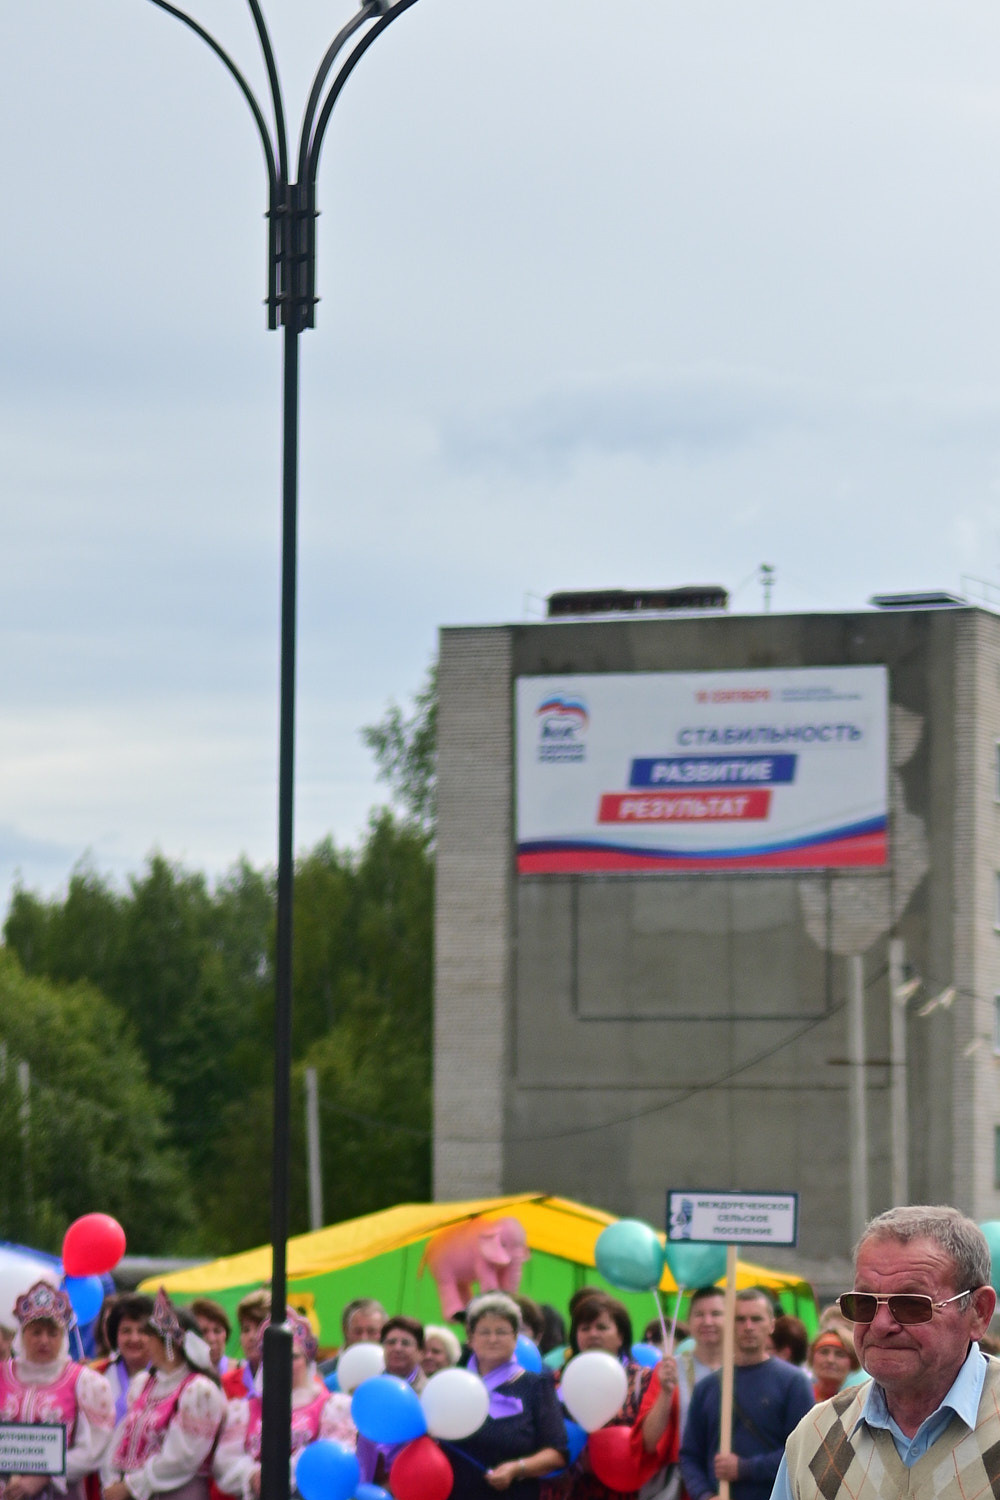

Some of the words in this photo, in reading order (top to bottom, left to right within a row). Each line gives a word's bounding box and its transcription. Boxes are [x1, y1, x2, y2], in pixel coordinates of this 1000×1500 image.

[677, 725, 862, 746] СТАБИЛЬНОСТЬ
[651, 760, 773, 783] РАЗВИТИЕ
[619, 798, 748, 819] РЕЗУЛЬТАТ
[718, 1214, 769, 1223] СЕЛЬСКОЕ
[713, 1226, 772, 1236] ПОСЕЛЕНИЕ
